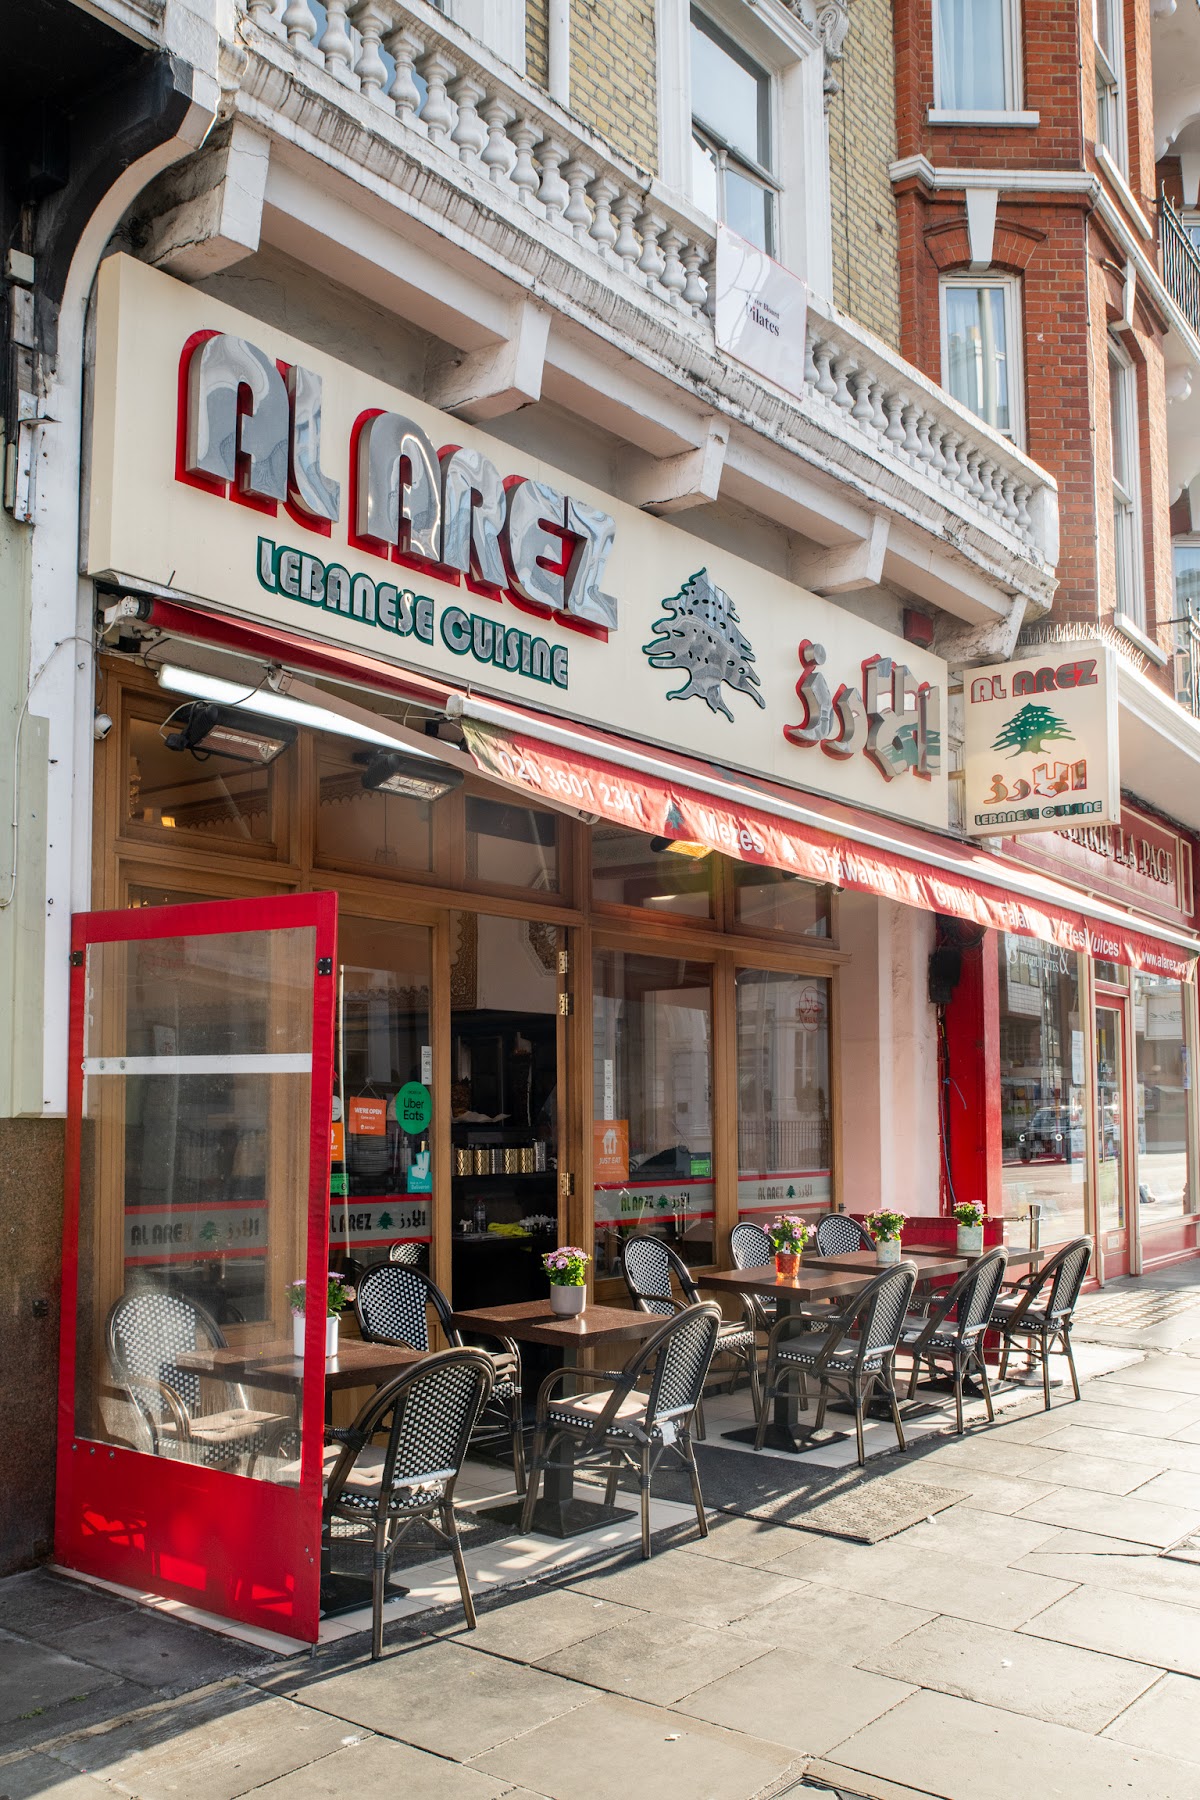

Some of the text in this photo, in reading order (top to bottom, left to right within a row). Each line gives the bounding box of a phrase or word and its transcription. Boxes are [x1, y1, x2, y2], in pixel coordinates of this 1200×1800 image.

[175, 329, 618, 643] AL AREZ
[257, 535, 569, 690] LEBANESE CUISINE
[971, 658, 1099, 704] AL AREZ
[498, 750, 542, 784] 020
[542, 766, 596, 802] 3601
[598, 782, 644, 818] 2341
[699, 810, 766, 854] Mezes
[975, 800, 1103, 827] LEBANESE CUISINE
[1140, 838, 1174, 884] PAGE
[403, 1098, 425, 1109] Uber
[403, 1110, 425, 1121] Eats
[598, 1156, 622, 1166] JUST EAT
[766, 1185, 784, 1200] AREZ
[130, 1224, 149, 1246] AL
[340, 1213, 372, 1233] AREZ
